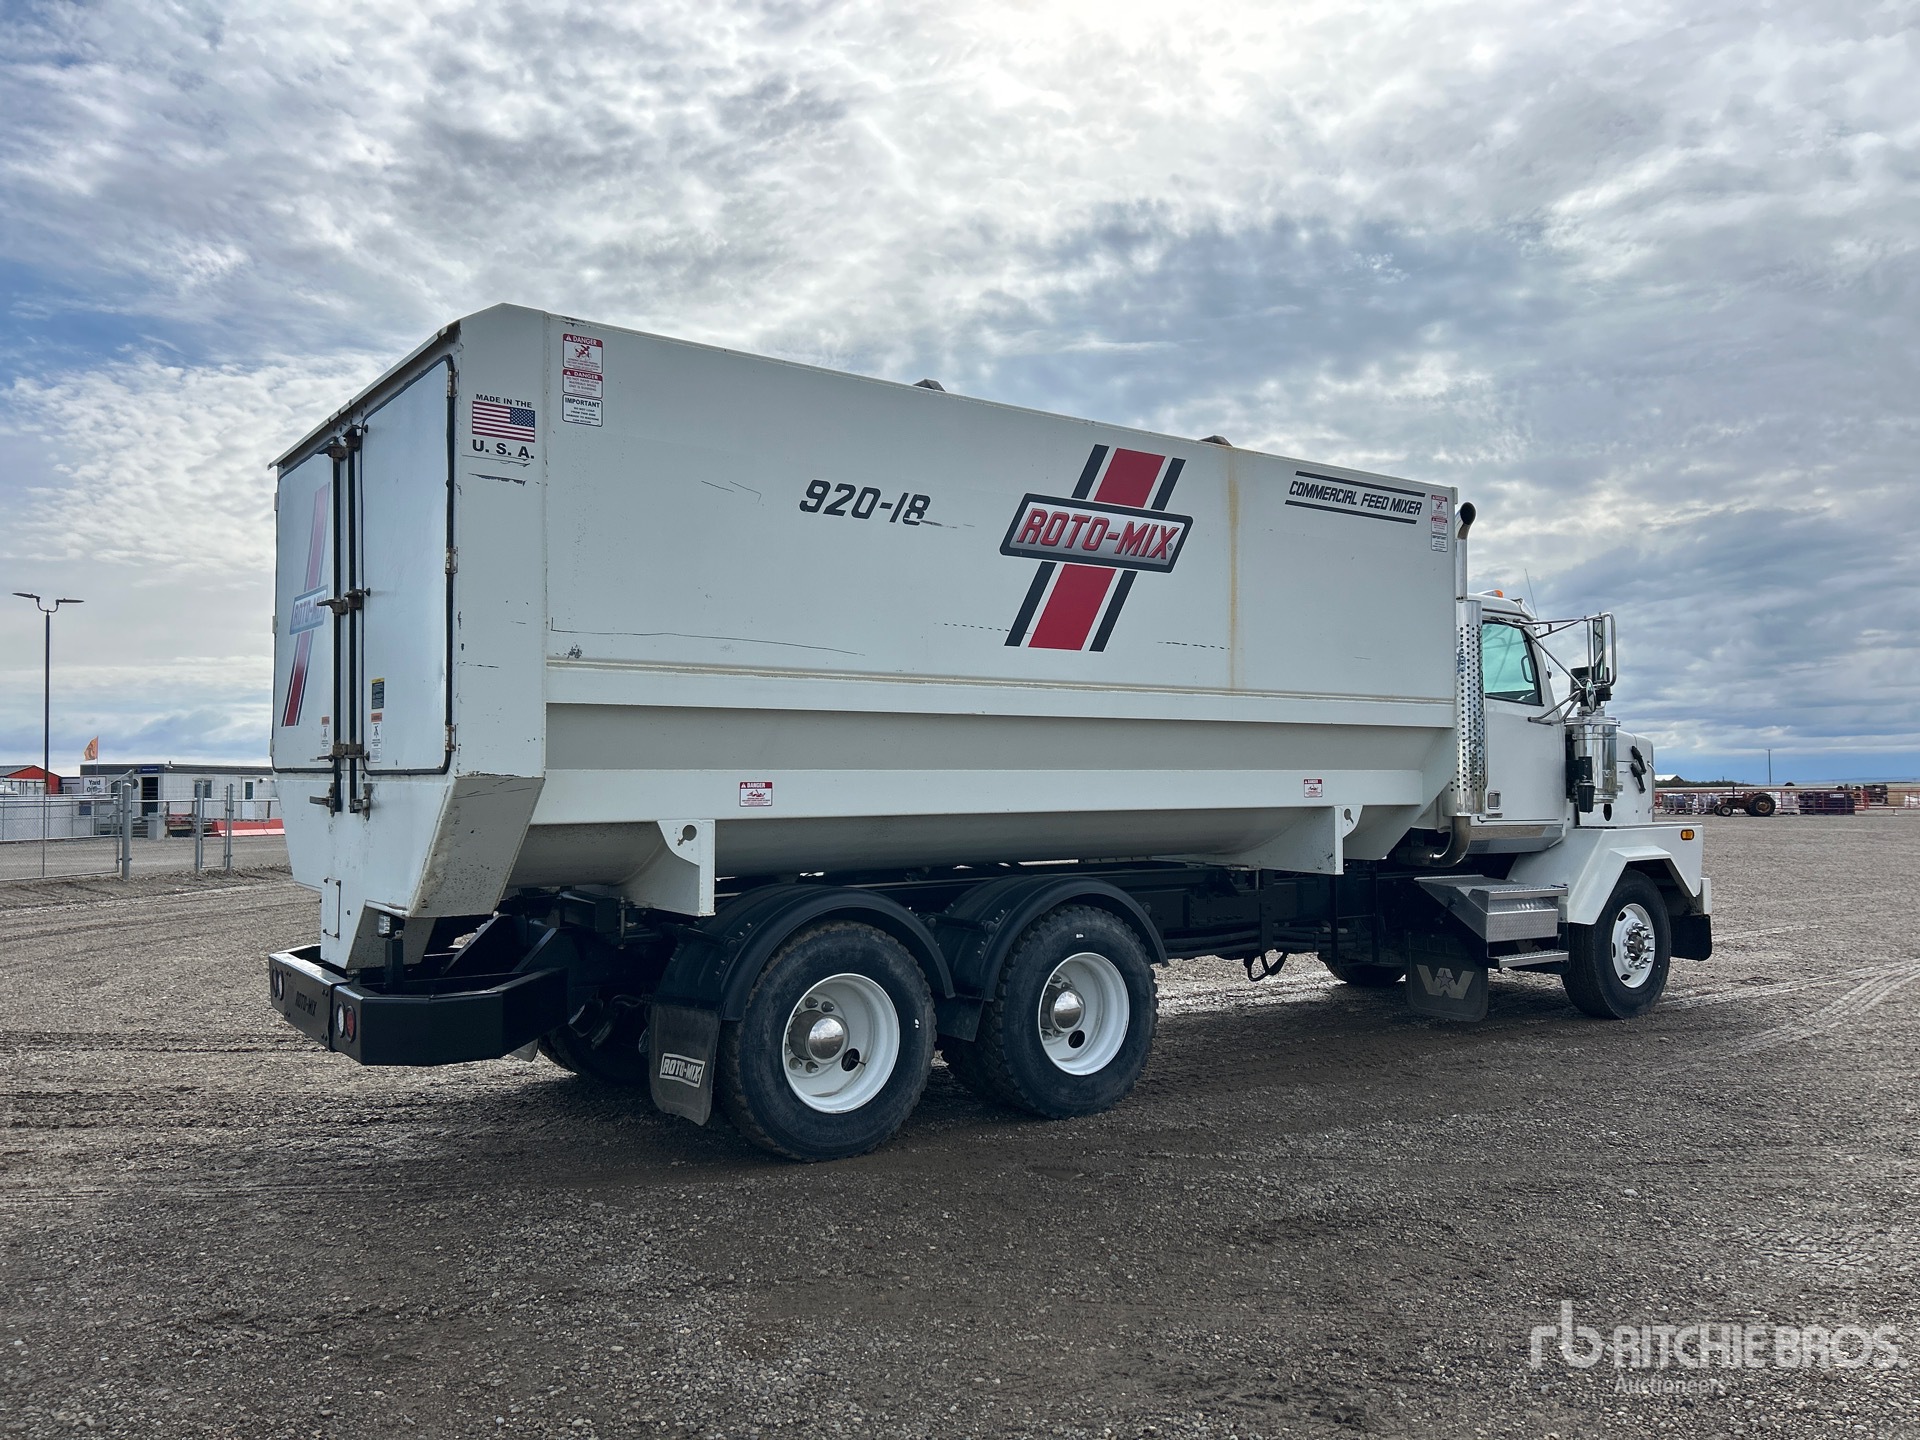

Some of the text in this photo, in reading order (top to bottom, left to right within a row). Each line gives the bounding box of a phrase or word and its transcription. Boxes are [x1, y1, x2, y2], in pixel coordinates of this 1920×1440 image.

[573, 335, 597, 346] DANGER
[573, 370, 599, 379] DANGER
[475, 393, 532, 408] MADE IN THE
[565, 397, 600, 408] IMPORTANT
[799, 479, 931, 526] 920-18
[1288, 480, 1423, 516] COMMERCIAL FEED MIXER
[662, 1058, 702, 1082] ROTO-MIX
